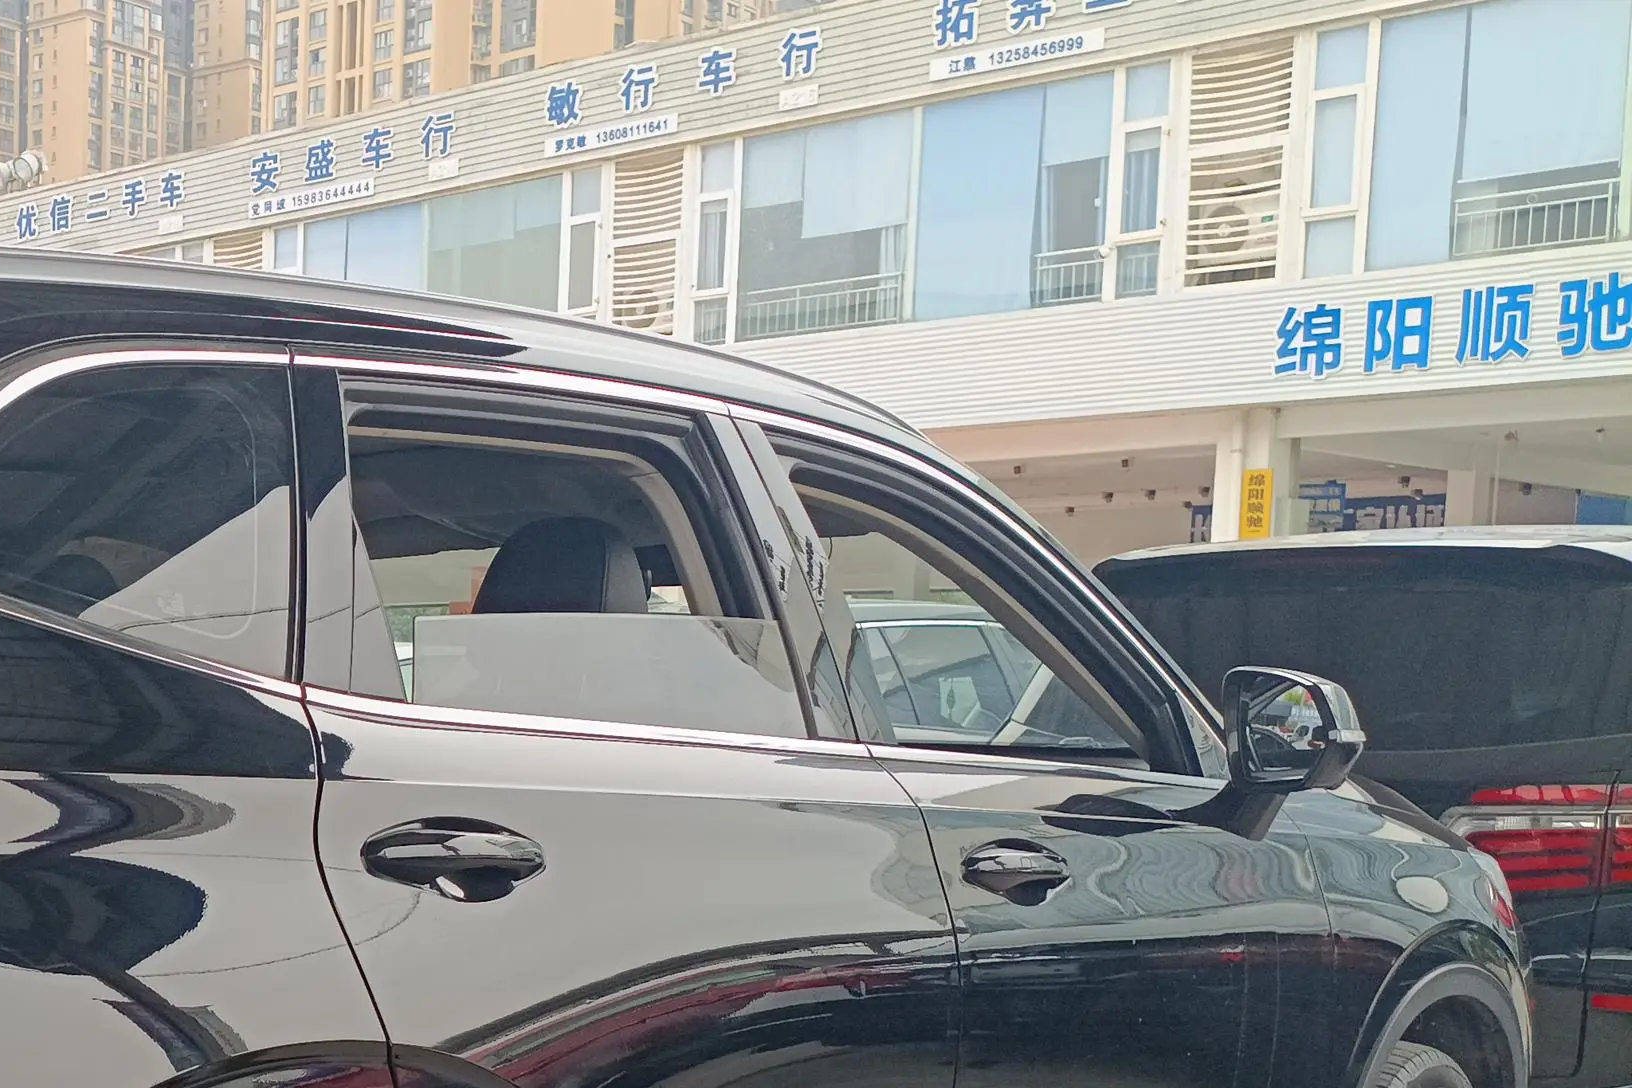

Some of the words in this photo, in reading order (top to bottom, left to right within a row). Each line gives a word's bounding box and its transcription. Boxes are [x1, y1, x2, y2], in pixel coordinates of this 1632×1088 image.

[545, 30, 819, 126] 敏行车行
[988, 35, 1084, 66] 13258456999
[250, 112, 454, 193] 安盛车行
[595, 119, 669, 144] 13608111641
[17, 171, 183, 240] 优信二手车
[291, 181, 370, 207] 15983644444
[1273, 272, 1632, 377] 绵阳顺驰
